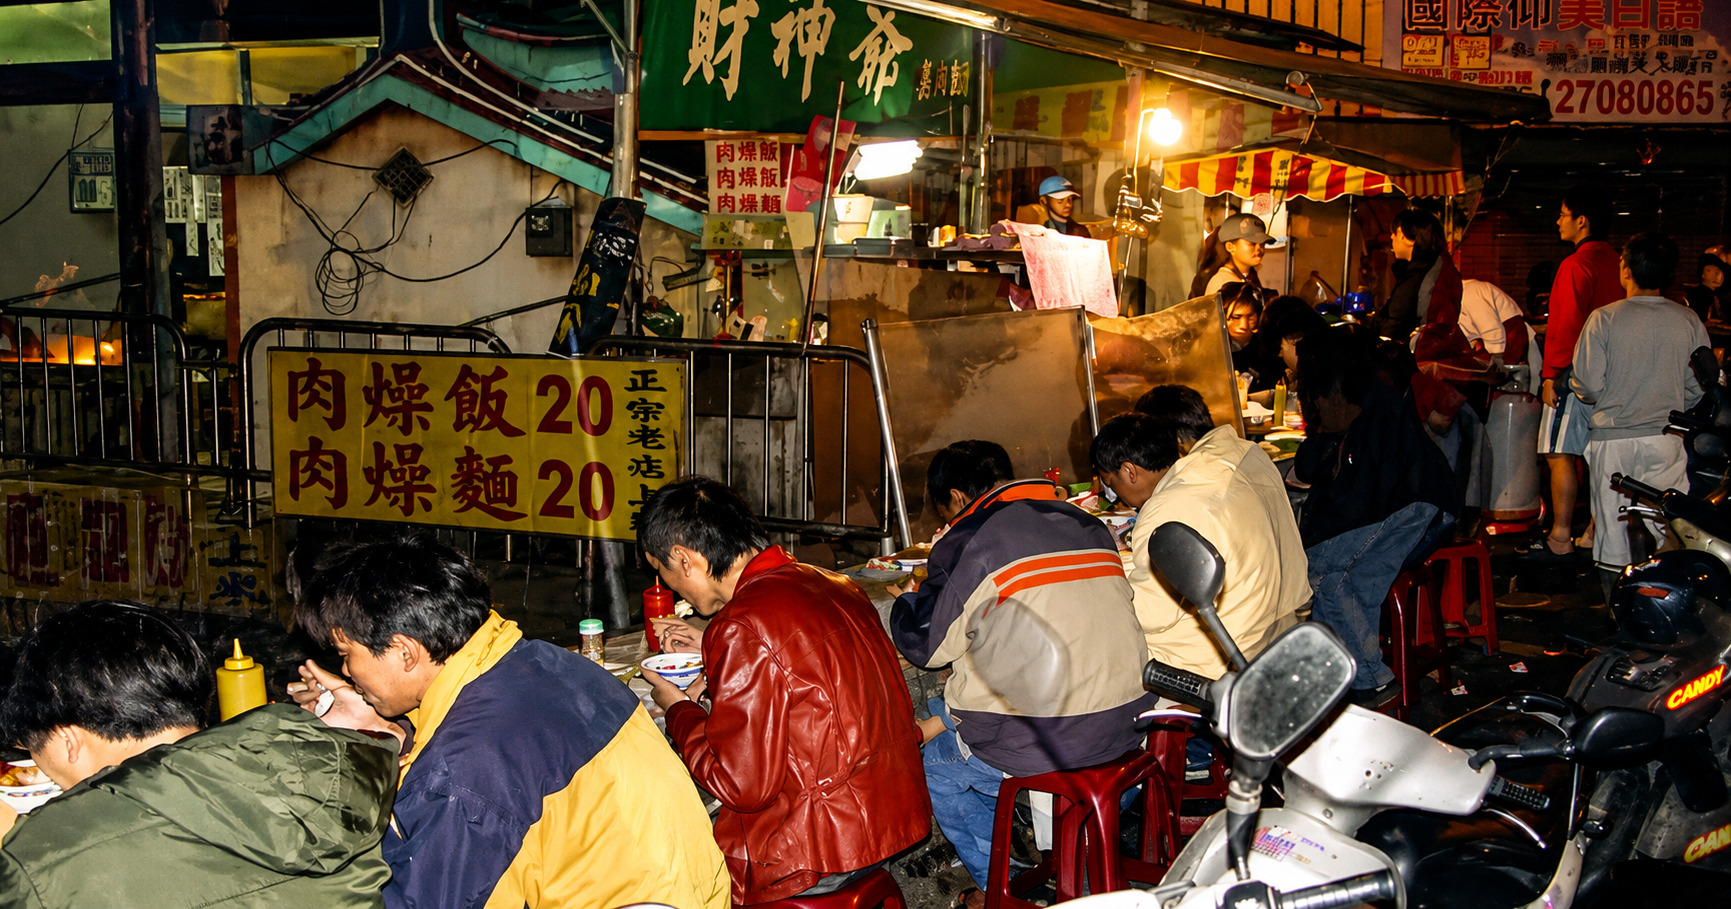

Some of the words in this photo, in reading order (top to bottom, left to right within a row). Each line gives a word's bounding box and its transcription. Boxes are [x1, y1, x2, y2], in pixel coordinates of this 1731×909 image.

[1555, 79, 1715, 115] 27080865
[287, 357, 527, 438] 肉燥飯
[536, 374, 614, 437] 20
[288, 435, 529, 522] 肉燥麵
[538, 459, 615, 521] 20
[1667, 664, 1726, 710] CANDY
